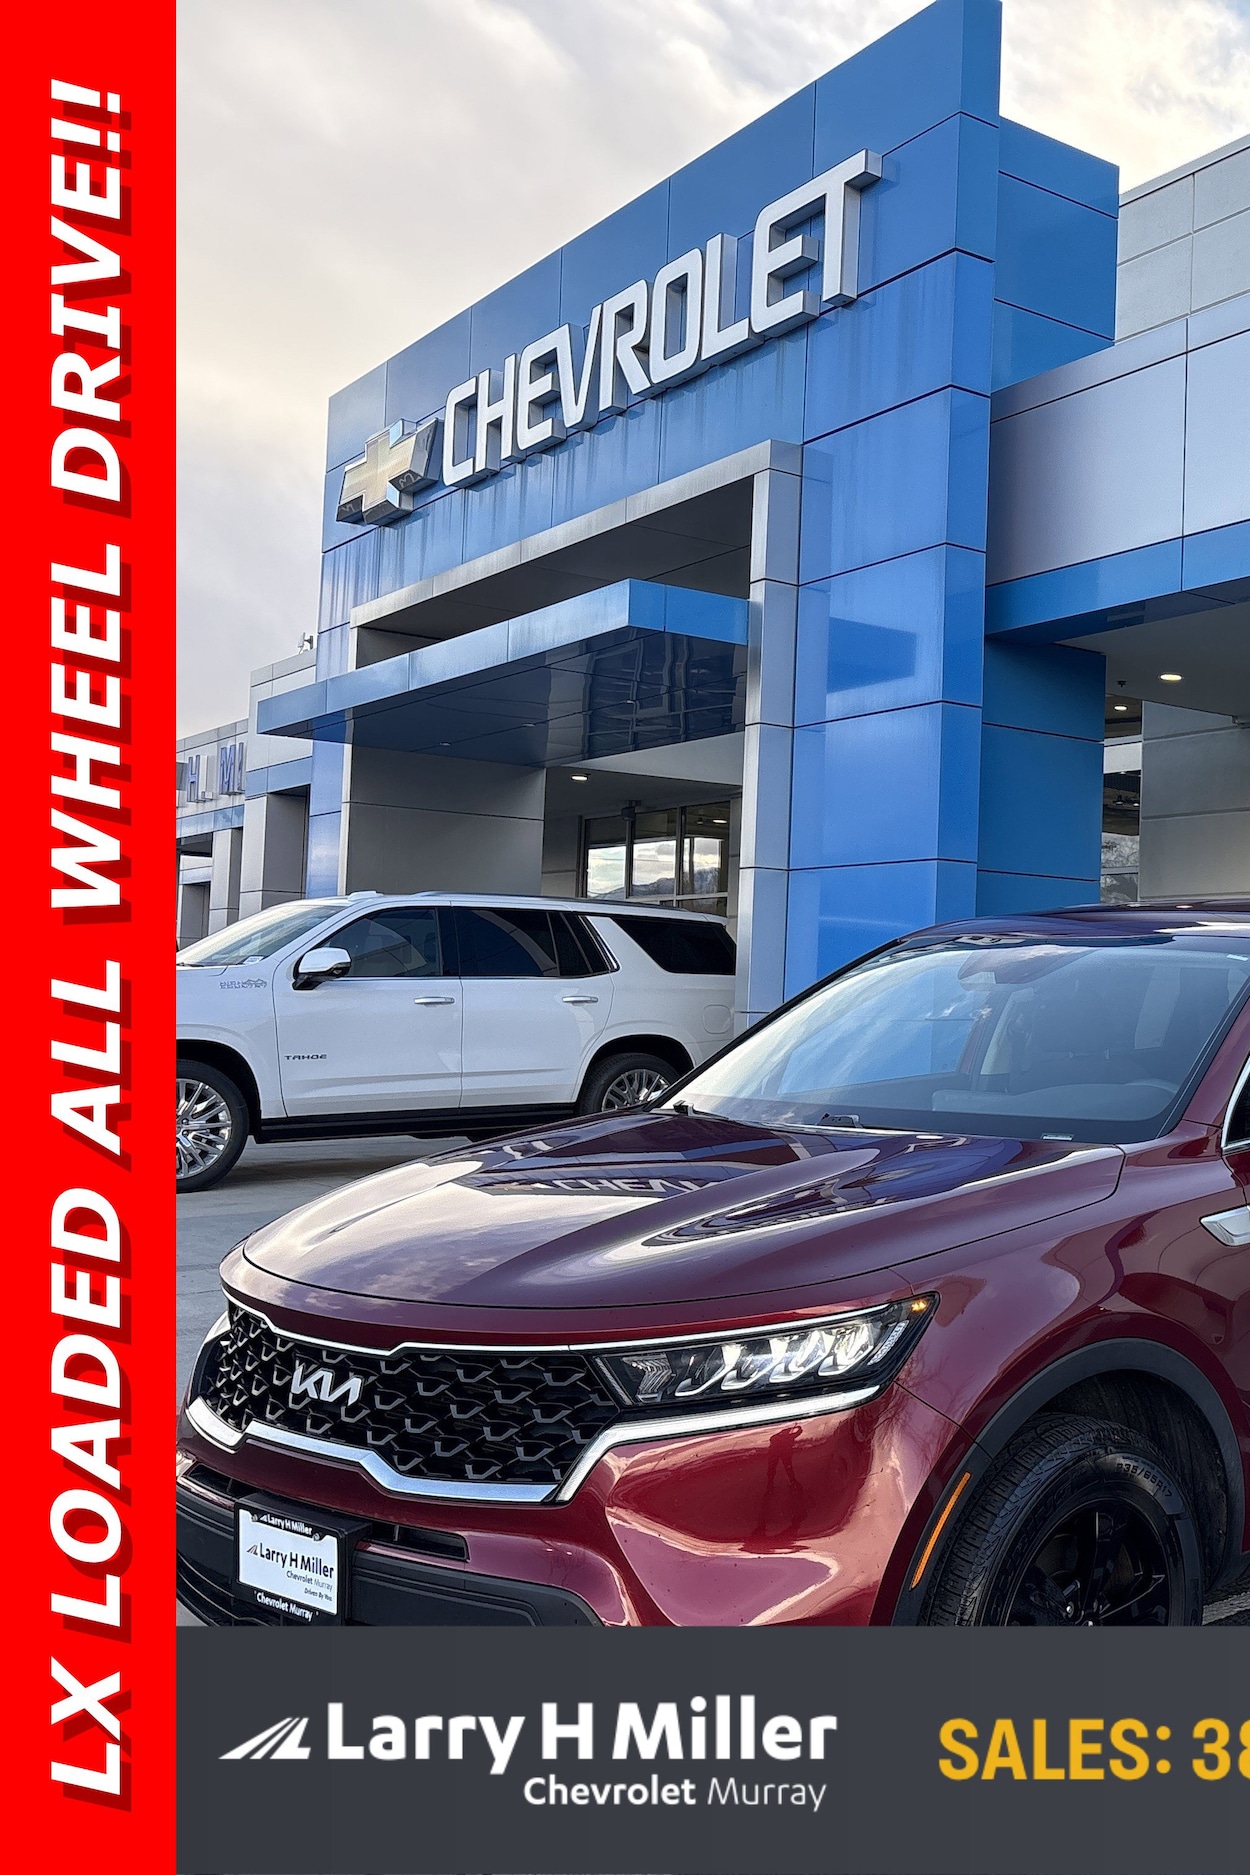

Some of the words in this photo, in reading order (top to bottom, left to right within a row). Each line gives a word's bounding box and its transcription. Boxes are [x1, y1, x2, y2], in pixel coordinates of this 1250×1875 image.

[443, 147, 882, 488] CHEVROLET
[291, 1364, 362, 1407] KIA
[267, 1513, 285, 1530] Larry
[291, 1521, 313, 1536] Miller
[259, 1542, 288, 1568] Larry
[289, 1551, 298, 1568] H
[300, 1555, 334, 1579] Miller
[286, 1570, 313, 1585] Chevrolet
[256, 1592, 289, 1611] Chevrolet
[289, 1603, 314, 1622] Murray
